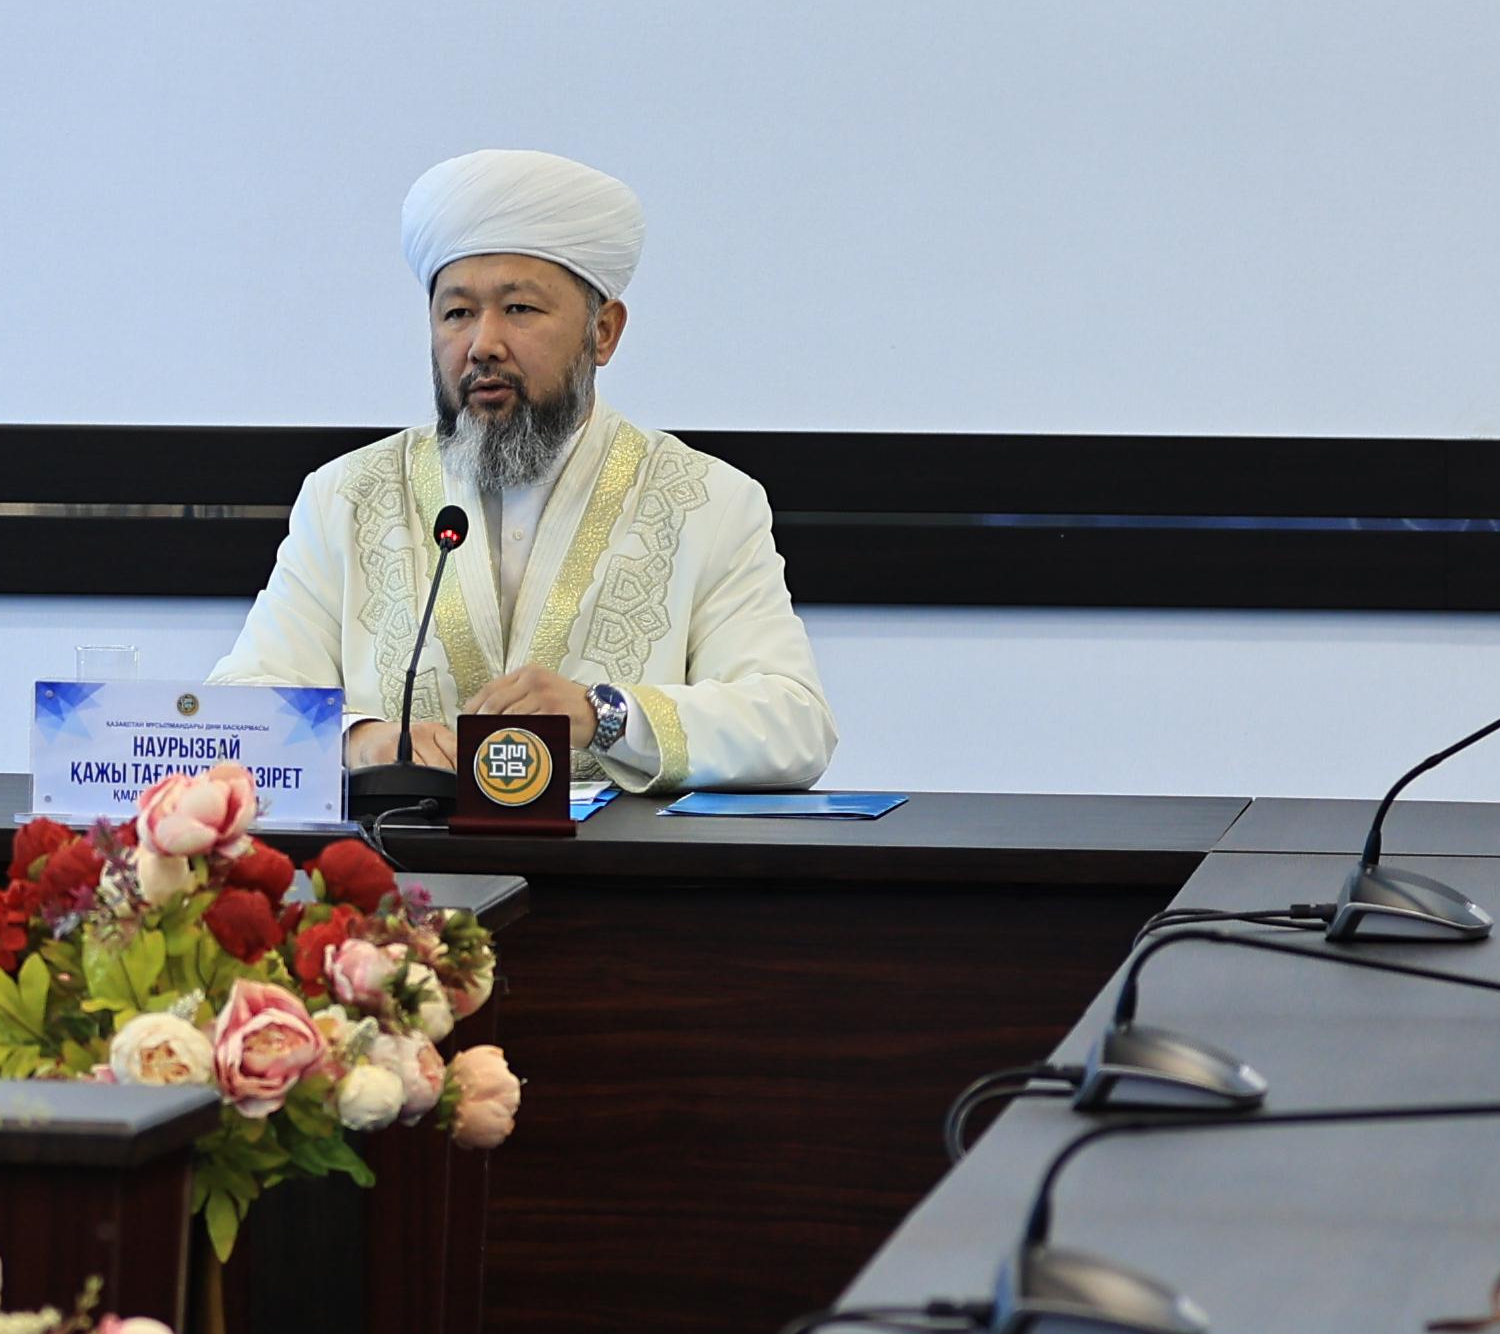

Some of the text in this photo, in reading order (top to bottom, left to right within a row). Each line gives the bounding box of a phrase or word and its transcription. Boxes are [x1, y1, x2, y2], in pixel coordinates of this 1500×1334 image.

[133, 734, 240, 760] НАУРЫЗБАЙ
[71, 761, 126, 785] ҚАЖЫ
[113, 789, 144, 803] ҚМД
